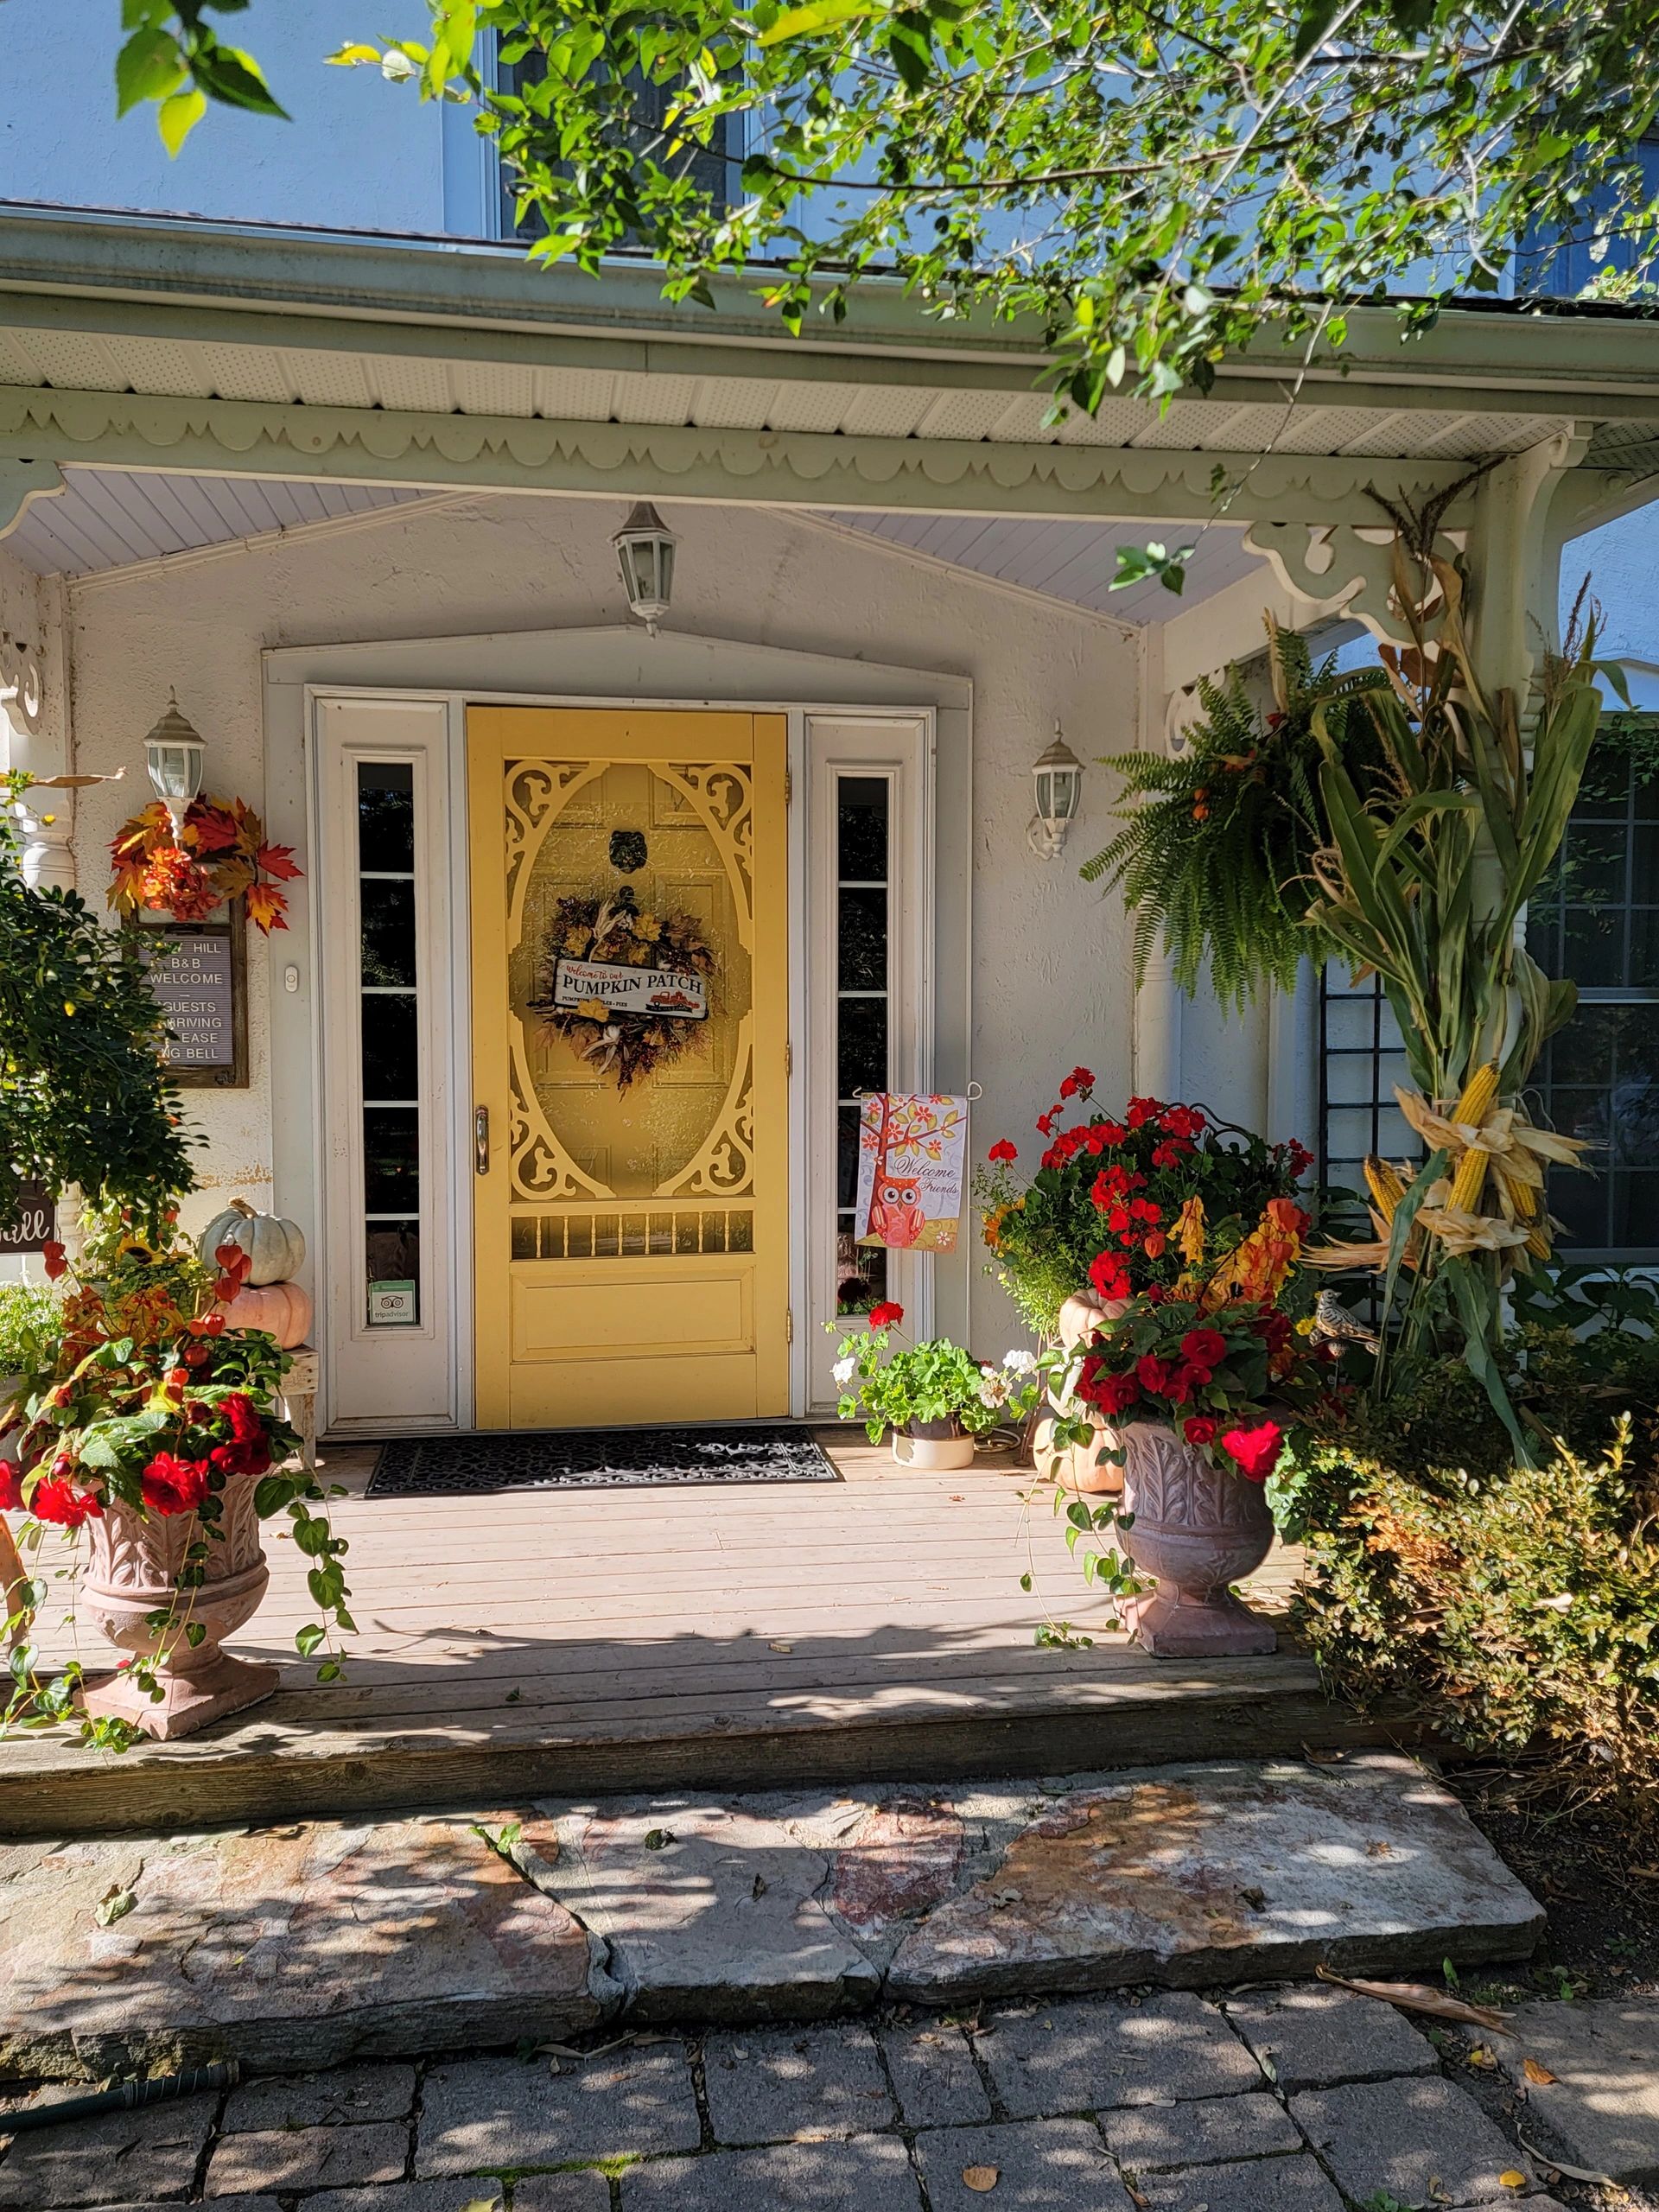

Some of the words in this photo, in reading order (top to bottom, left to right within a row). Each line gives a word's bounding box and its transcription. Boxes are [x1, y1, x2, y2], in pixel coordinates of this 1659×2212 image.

[194, 943, 222, 953] HILL
[171, 958, 200, 969] B&B
[566, 964, 597, 979] welcome
[149, 973, 223, 984] WELCOME
[563, 975, 642, 995] PUMPKIN
[647, 975, 702, 995] PATCH
[162, 1001, 216, 1012] GUESTS
[181, 1033, 218, 1043] EASE
[186, 1048, 219, 1059] BELL
[894, 1155, 956, 1178] Welcome
[918, 1178, 959, 1194] Friends
[374, 1311, 409, 1319] tripadvisor
